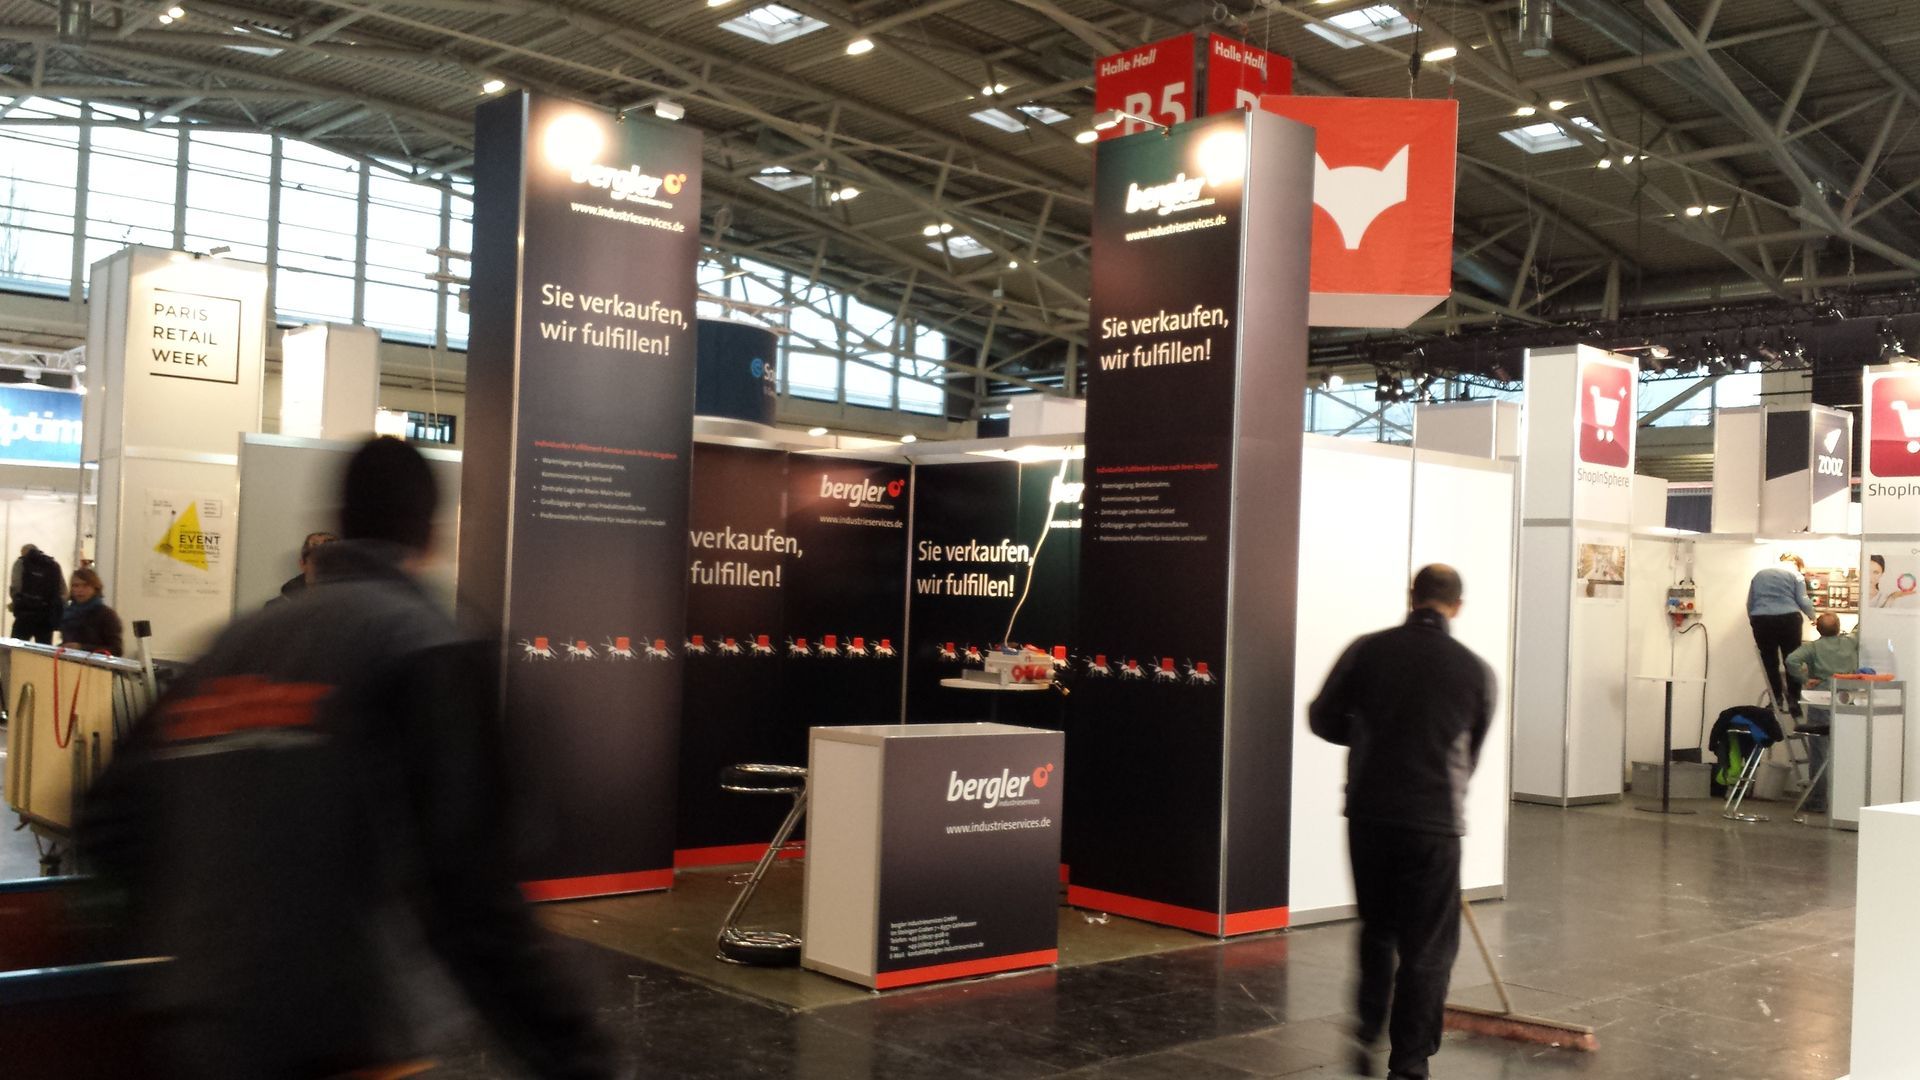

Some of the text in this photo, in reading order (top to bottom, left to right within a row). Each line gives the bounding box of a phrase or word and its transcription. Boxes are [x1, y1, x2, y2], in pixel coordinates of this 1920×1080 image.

[1101, 48, 1157, 77] Halle Hall
[1215, 40, 1265, 69] Halle Hall
[1124, 81, 1186, 136] B5
[570, 202, 685, 233] www.industrieservices.de
[1125, 214, 1227, 242] www.industrieservices.de
[154, 303, 208, 321] PARIS
[541, 283, 688, 331] Sie verkaufen,
[152, 325, 218, 346] RETAIL
[1102, 304, 1229, 340] Sie verkaufen,
[540, 321, 670, 356] wir fulfillen!
[152, 348, 208, 367] WEEK
[1100, 338, 1212, 371] wir fulfillen!
[820, 475, 886, 507] bergler
[1577, 467, 1630, 488] ShopInSphere
[819, 514, 904, 529] www.industrieservices.de
[179, 534, 221, 545] EVENT
[690, 526, 803, 558] verkaufen,
[918, 539, 1034, 566] Sie verkaufen,
[690, 560, 782, 587] fulfillen!
[917, 573, 1015, 597] wir fulfillen!
[947, 768, 1030, 809] bergler
[945, 816, 1052, 834] www.industrieservices.de
